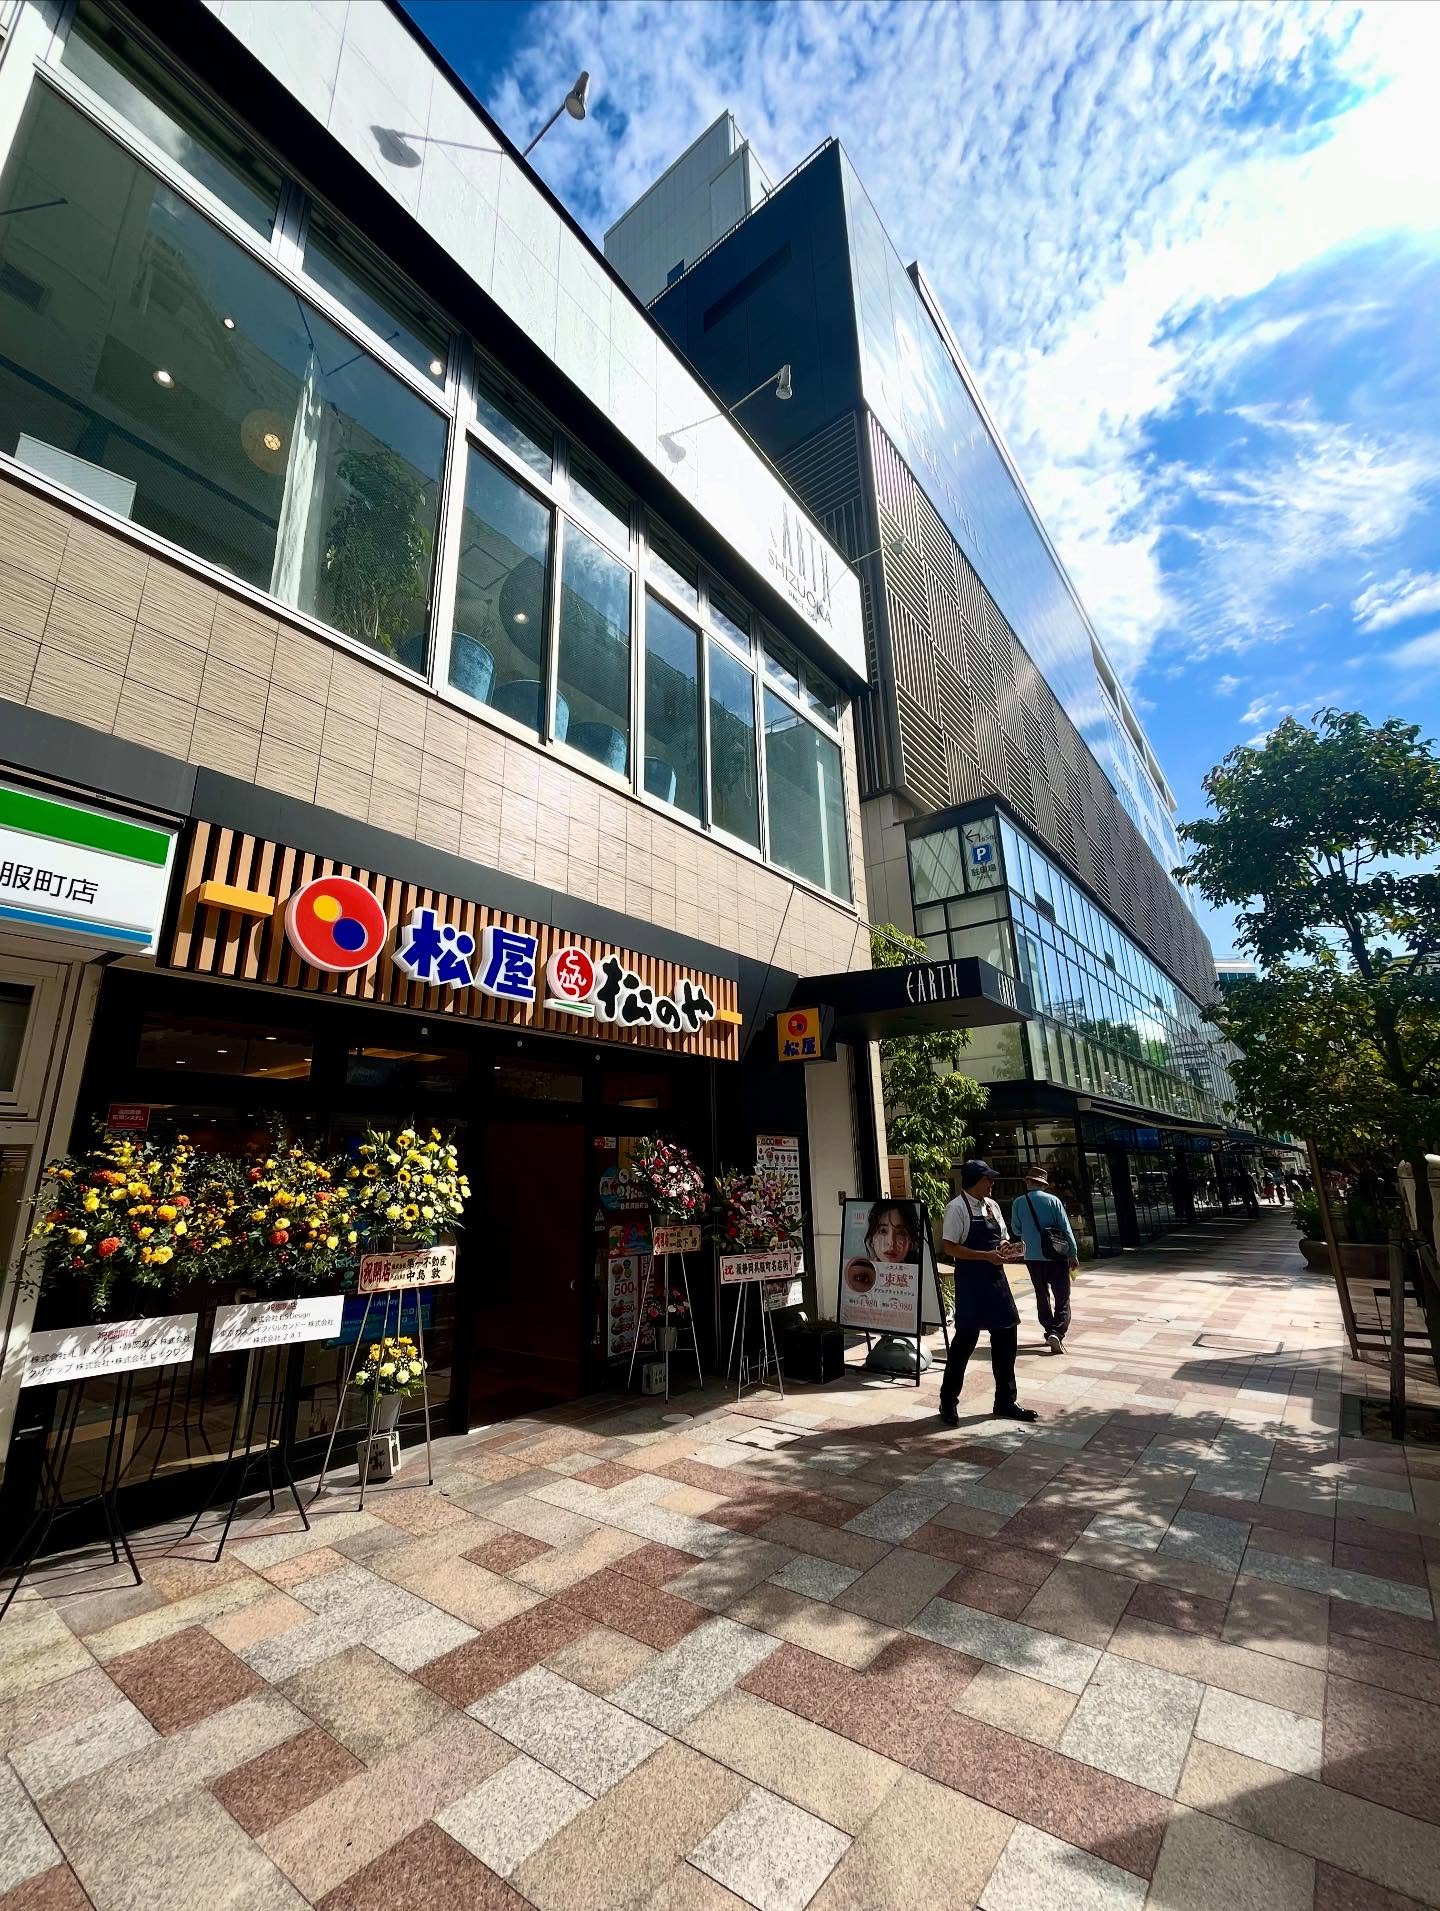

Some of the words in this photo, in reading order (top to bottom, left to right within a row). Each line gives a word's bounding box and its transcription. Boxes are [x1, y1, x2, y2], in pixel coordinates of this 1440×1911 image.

[768, 548, 833, 629] SHIZUOKA
[0, 861, 99, 905] 服町店
[400, 909, 536, 993] 松屋
[595, 955, 715, 1031] 松のや
[906, 963, 960, 1003] EARTH
[783, 1036, 817, 1057] 松屋
[406, 1256, 447, 1270] 第一不動産
[307, 1318, 334, 1328] 株式会社
